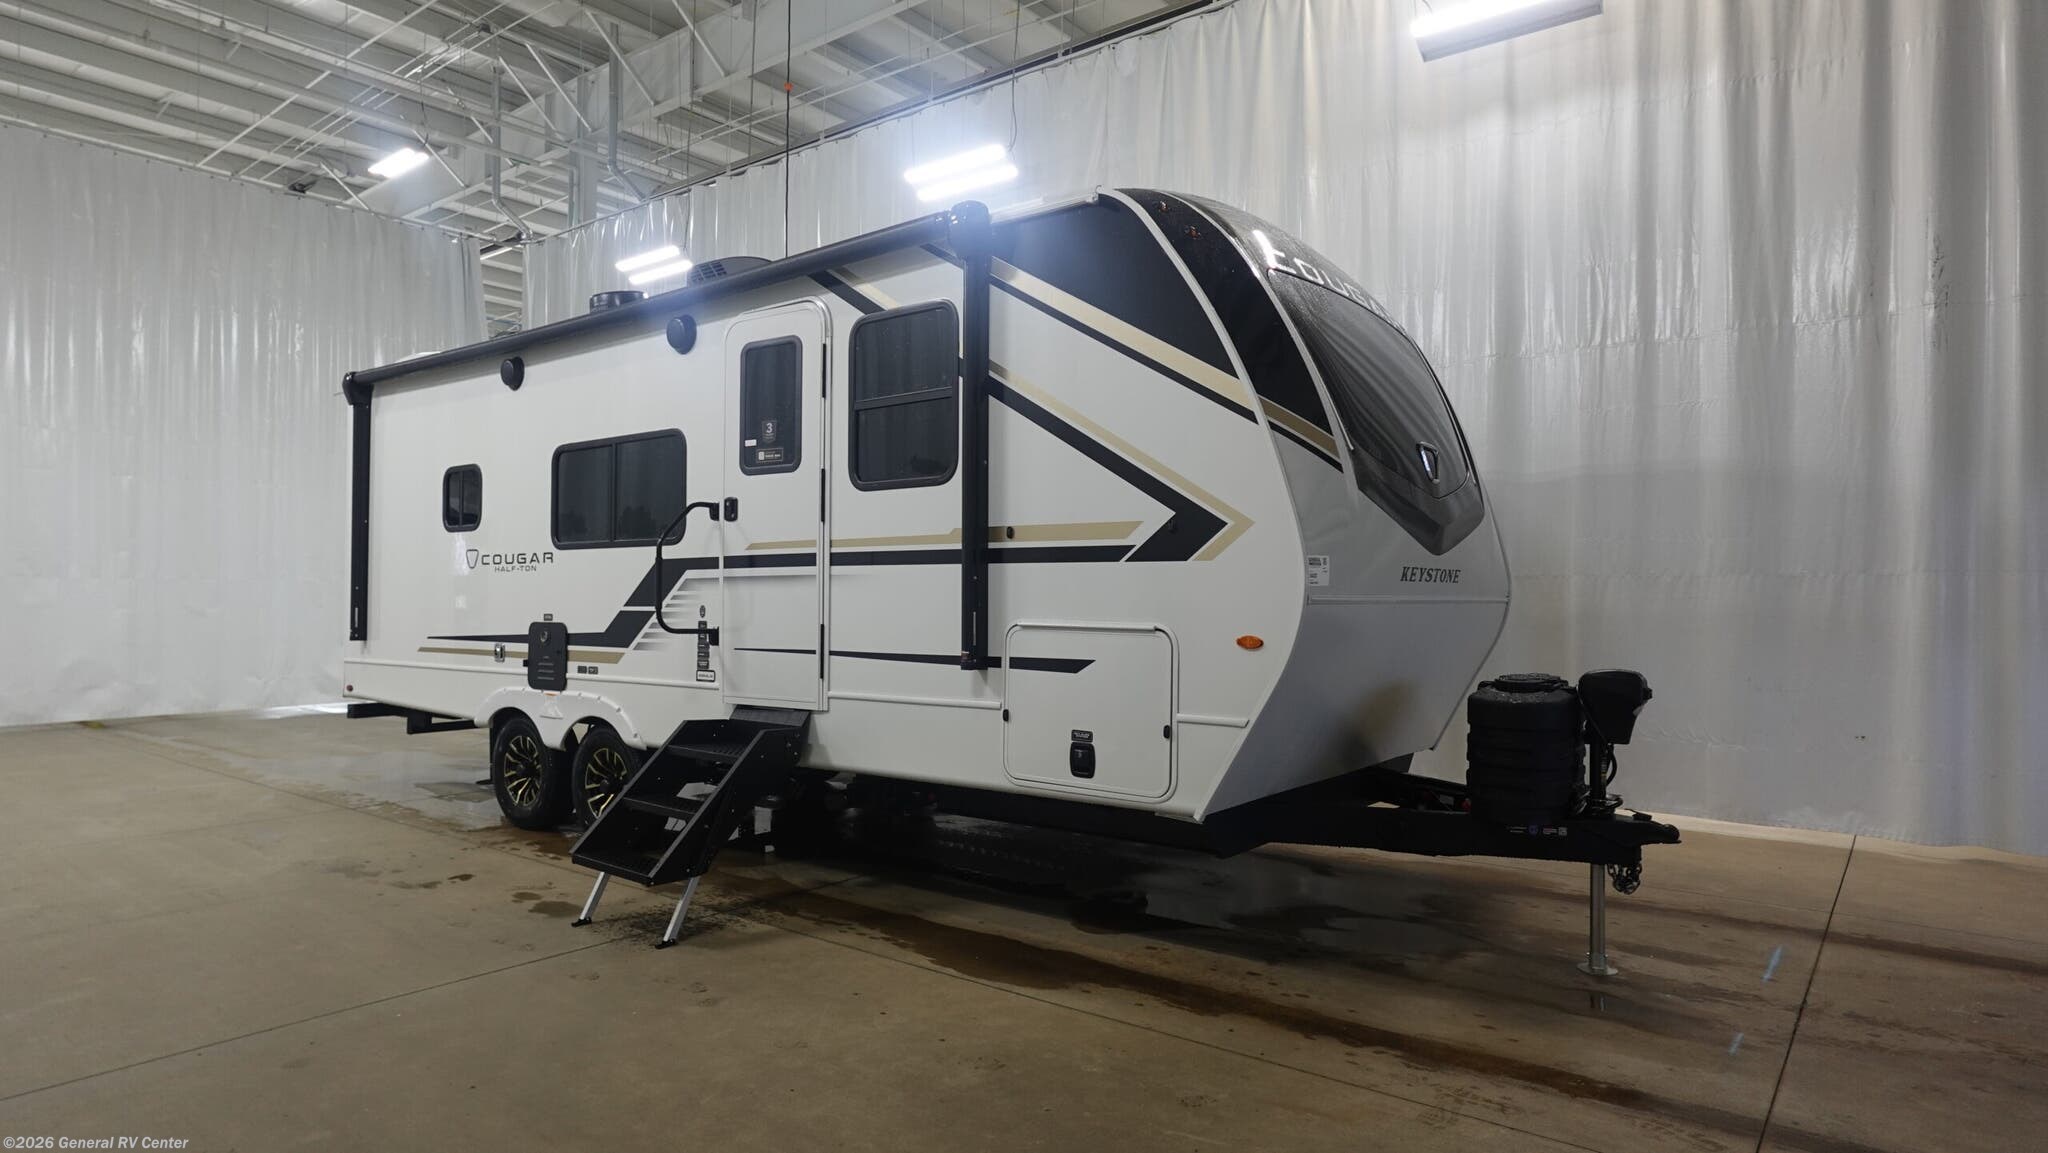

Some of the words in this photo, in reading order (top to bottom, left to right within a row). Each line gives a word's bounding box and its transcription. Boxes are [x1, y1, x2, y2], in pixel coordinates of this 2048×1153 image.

[766, 422, 773, 434] 3
[481, 552, 554, 566] COUGAR
[494, 565, 537, 573] HALF-TON
[1400, 566, 1462, 584] KEYSTONE
